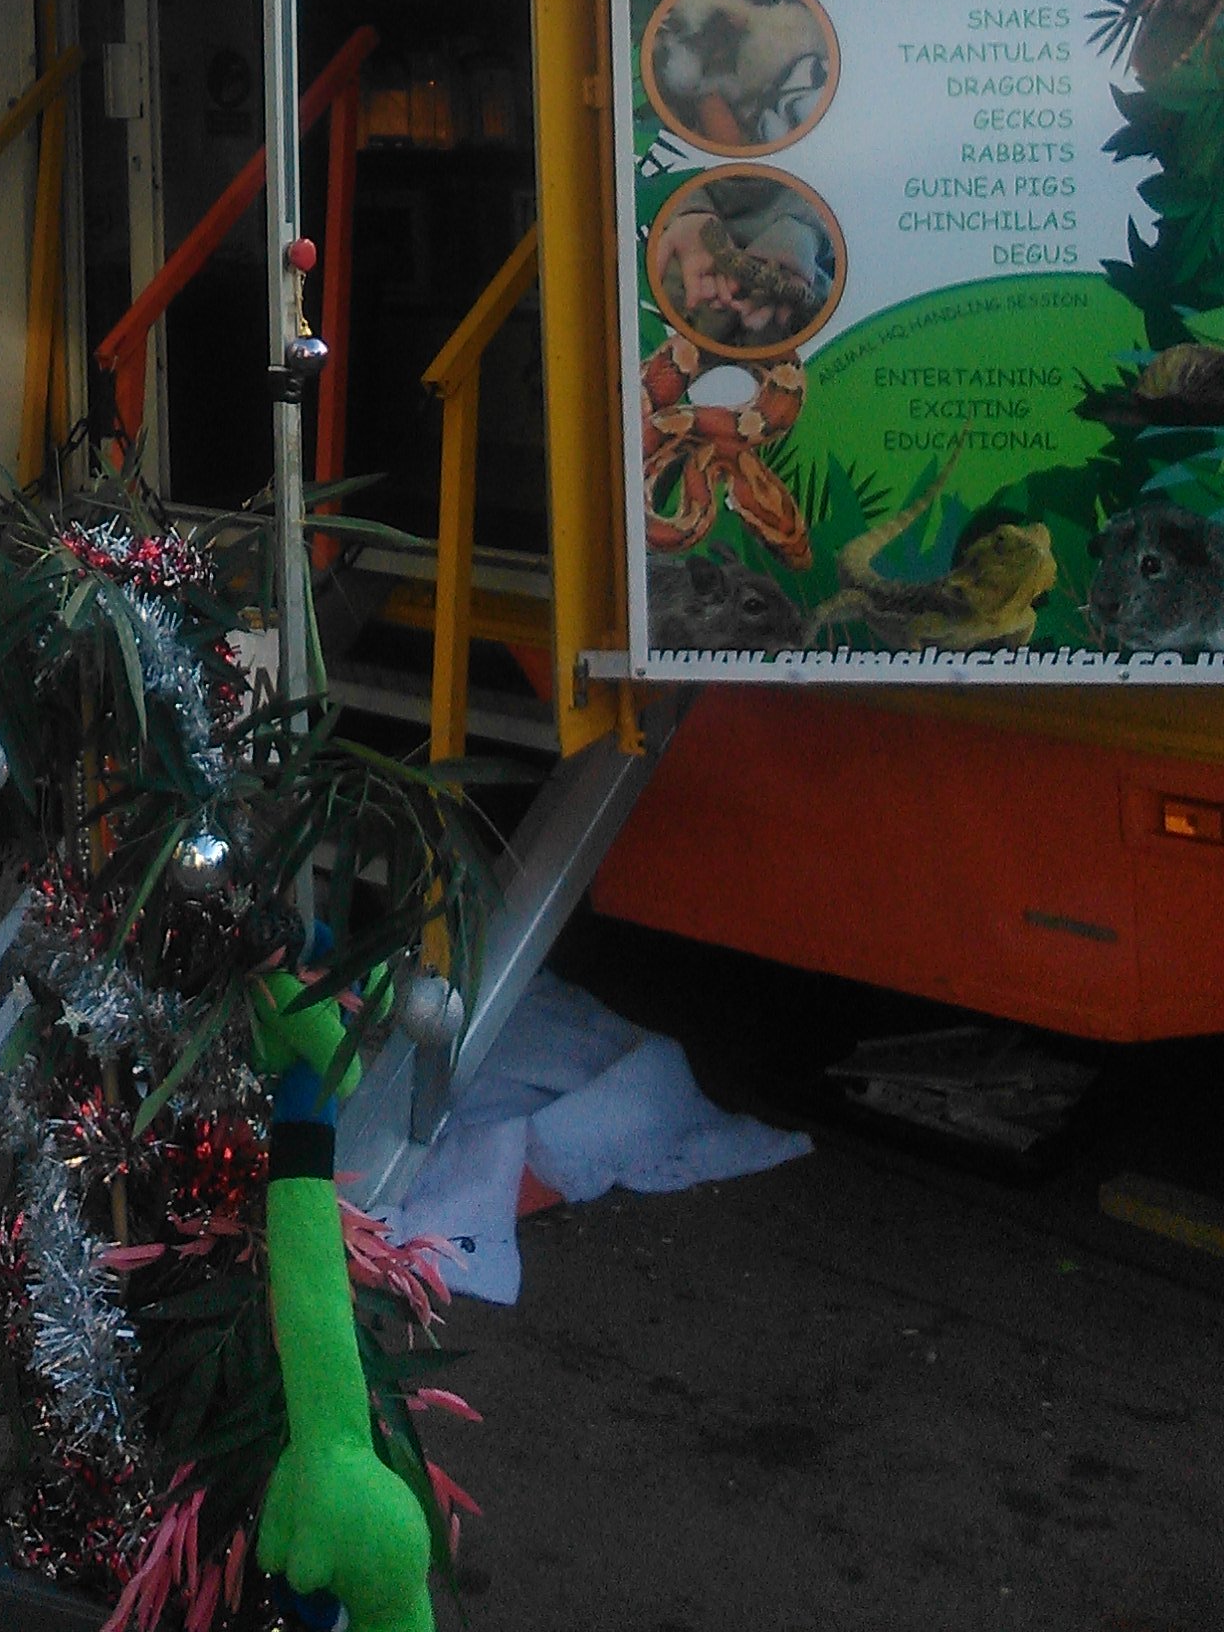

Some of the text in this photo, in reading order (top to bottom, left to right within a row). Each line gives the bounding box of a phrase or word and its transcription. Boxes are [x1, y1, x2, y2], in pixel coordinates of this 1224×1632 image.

[967, 8, 1071, 30] SNAKES
[898, 42, 1071, 64] TARANTULAS
[946, 75, 1072, 98] DRAGONS
[973, 109, 1074, 131] GECKOS
[960, 143, 1075, 164] RABBITS
[904, 177, 1076, 199] GUINEA PIGS
[898, 210, 1077, 232] CHINCHILLAS
[992, 244, 1078, 265] DEGUS
[819, 341, 877, 386] ANIMAL
[909, 297, 1001, 332] HANDLING
[1006, 292, 1090, 310] SESSION
[874, 367, 1062, 388] ENTERTAINING
[909, 398, 1031, 420] EXCITING
[883, 429, 1057, 451] EDUCATIONAL
